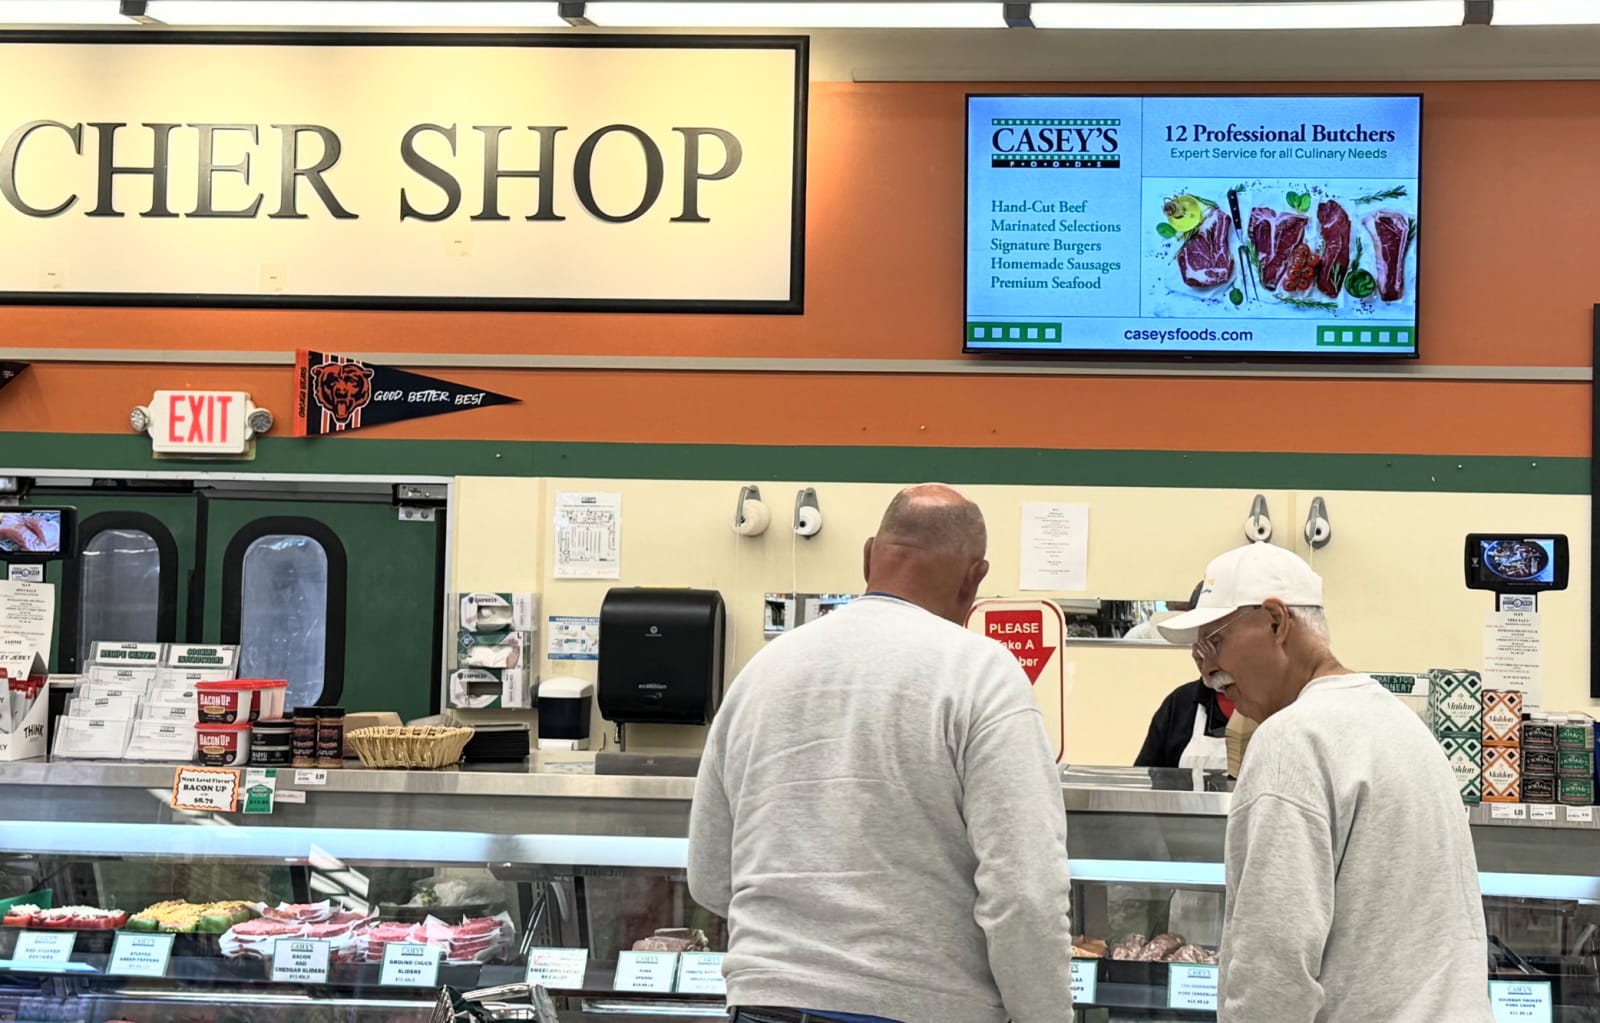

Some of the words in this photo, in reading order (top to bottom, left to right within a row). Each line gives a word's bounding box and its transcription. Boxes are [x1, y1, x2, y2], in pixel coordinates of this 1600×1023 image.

[991, 126, 1119, 153] CASEY'S
[1165, 125, 1188, 143] 12
[1193, 123, 1306, 144] Professional
[1311, 124, 1396, 144] Butchers
[1170, 147, 1210, 161] Expert
[1211, 147, 1257, 161] Service
[1259, 147, 1276, 160] for
[1278, 147, 1293, 160] all
[1294, 147, 1345, 162] Culinary
[1347, 148, 1388, 161] Needs
[399, 123, 743, 223] SHOP
[991, 200, 1056, 214] Hand-Cut
[1059, 200, 1088, 214] Beef
[991, 219, 1057, 233] Marinated
[1059, 219, 1122, 233] Selections
[990, 238, 1050, 254] Signature
[1053, 239, 1102, 254] Burgers
[990, 257, 1064, 270] Homemade
[1066, 257, 1122, 273] Sausages
[990, 276, 1049, 290] Premium
[1051, 276, 1102, 290] Seafood
[1124, 327, 1254, 344] caseysfoods.com
[374, 390, 404, 401] GOOD.
[407, 390, 450, 403] BETTER.
[454, 393, 486, 405] BEST
[168, 394, 233, 443] EXIT
[989, 623, 1039, 634] PLEASE
[1025, 639, 1035, 650] A
[1447, 702, 1475, 711] Maldon
[1488, 715, 1514, 723] Maldon
[24, 725, 44, 739] THINK
[1452, 765, 1475, 774] aldon
[183, 784, 213, 792] BACON
[215, 785, 227, 793] UP
